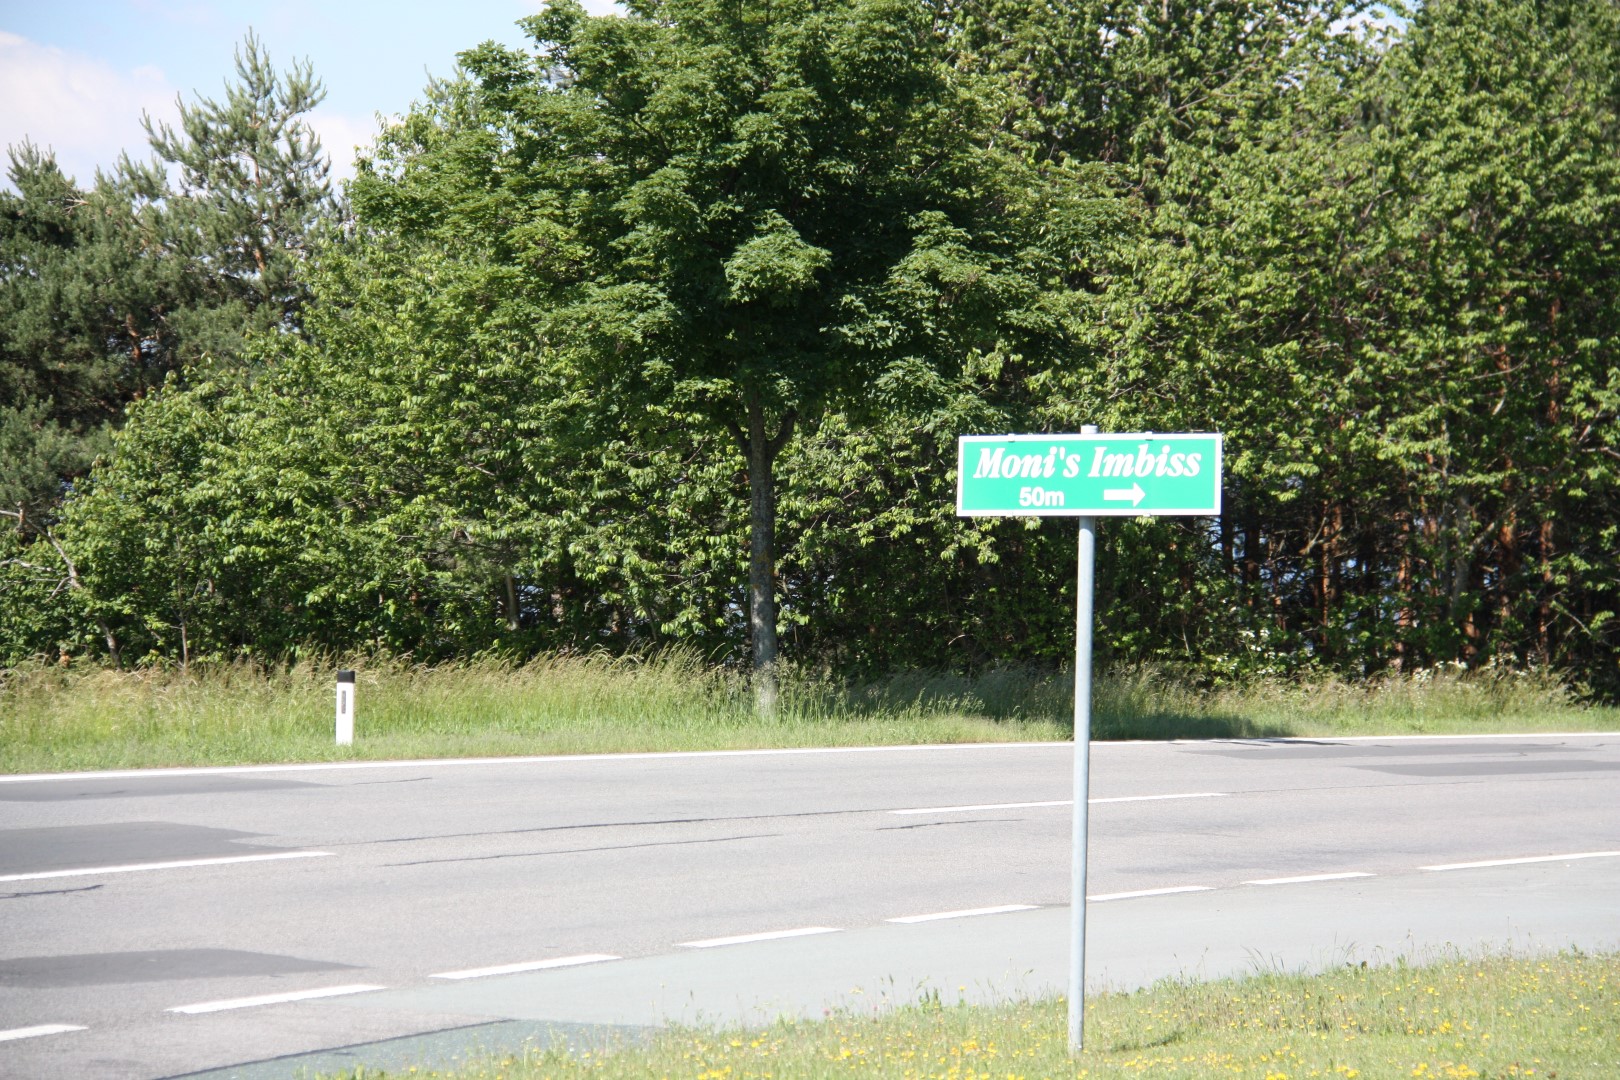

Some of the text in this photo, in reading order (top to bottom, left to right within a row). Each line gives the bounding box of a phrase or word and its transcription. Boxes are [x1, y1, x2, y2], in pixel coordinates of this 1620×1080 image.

[973, 444, 1202, 479] Moni's Imbiss
[1018, 486, 1065, 507] 50m
